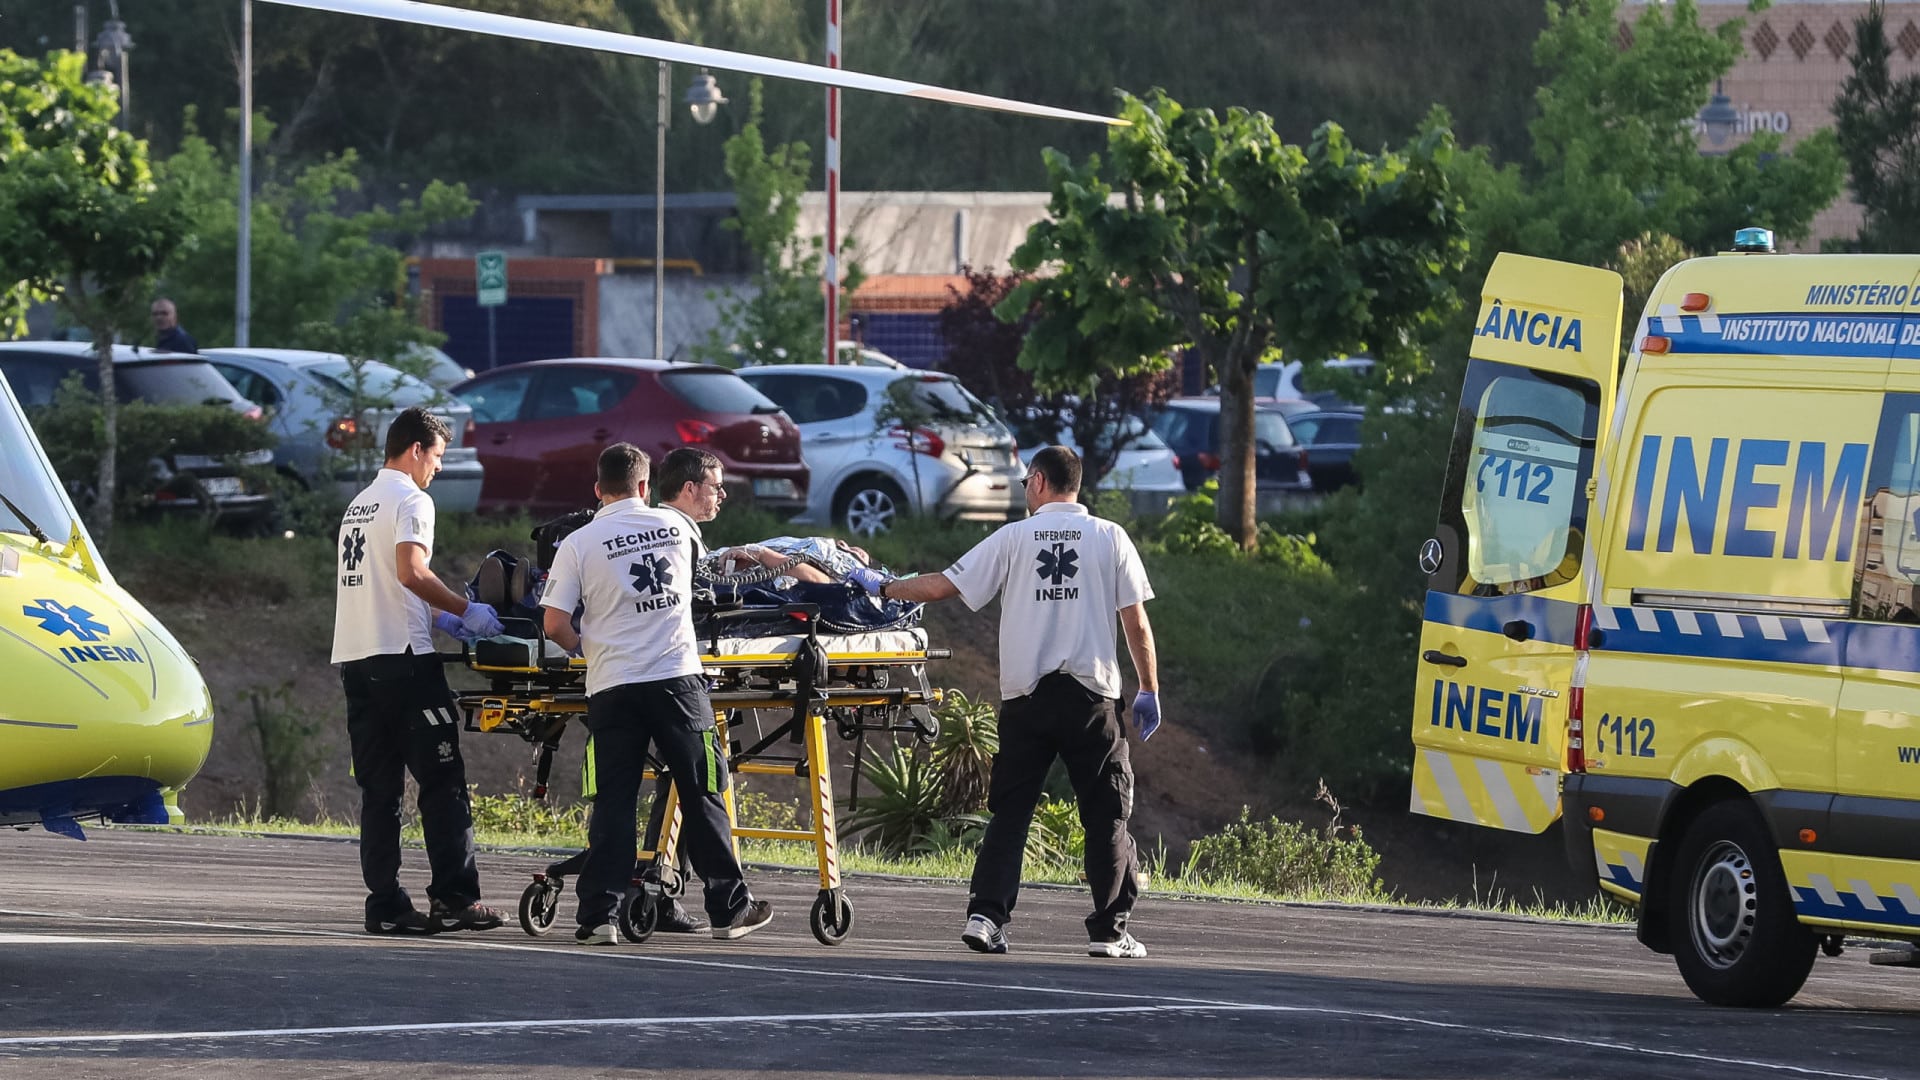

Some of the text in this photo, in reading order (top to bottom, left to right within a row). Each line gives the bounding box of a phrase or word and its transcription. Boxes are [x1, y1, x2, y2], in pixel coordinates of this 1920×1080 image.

[1805, 280, 1908, 306] MINISTÉRIO
[1721, 319, 1810, 342] INSTITUTO
[1811, 321, 1896, 344] NACIONAL
[1495, 459, 1553, 504] 112
[1626, 435, 1869, 562] INEM
[602, 527, 680, 551] TÉCNICO
[1034, 530, 1082, 541] ENFERMEIRO
[341, 575, 364, 587] NEM
[635, 594, 680, 613] INEM
[1036, 587, 1079, 601] INEM
[59, 645, 144, 664] INEM
[1431, 679, 1543, 745] INEM
[1610, 716, 1656, 758] 112
